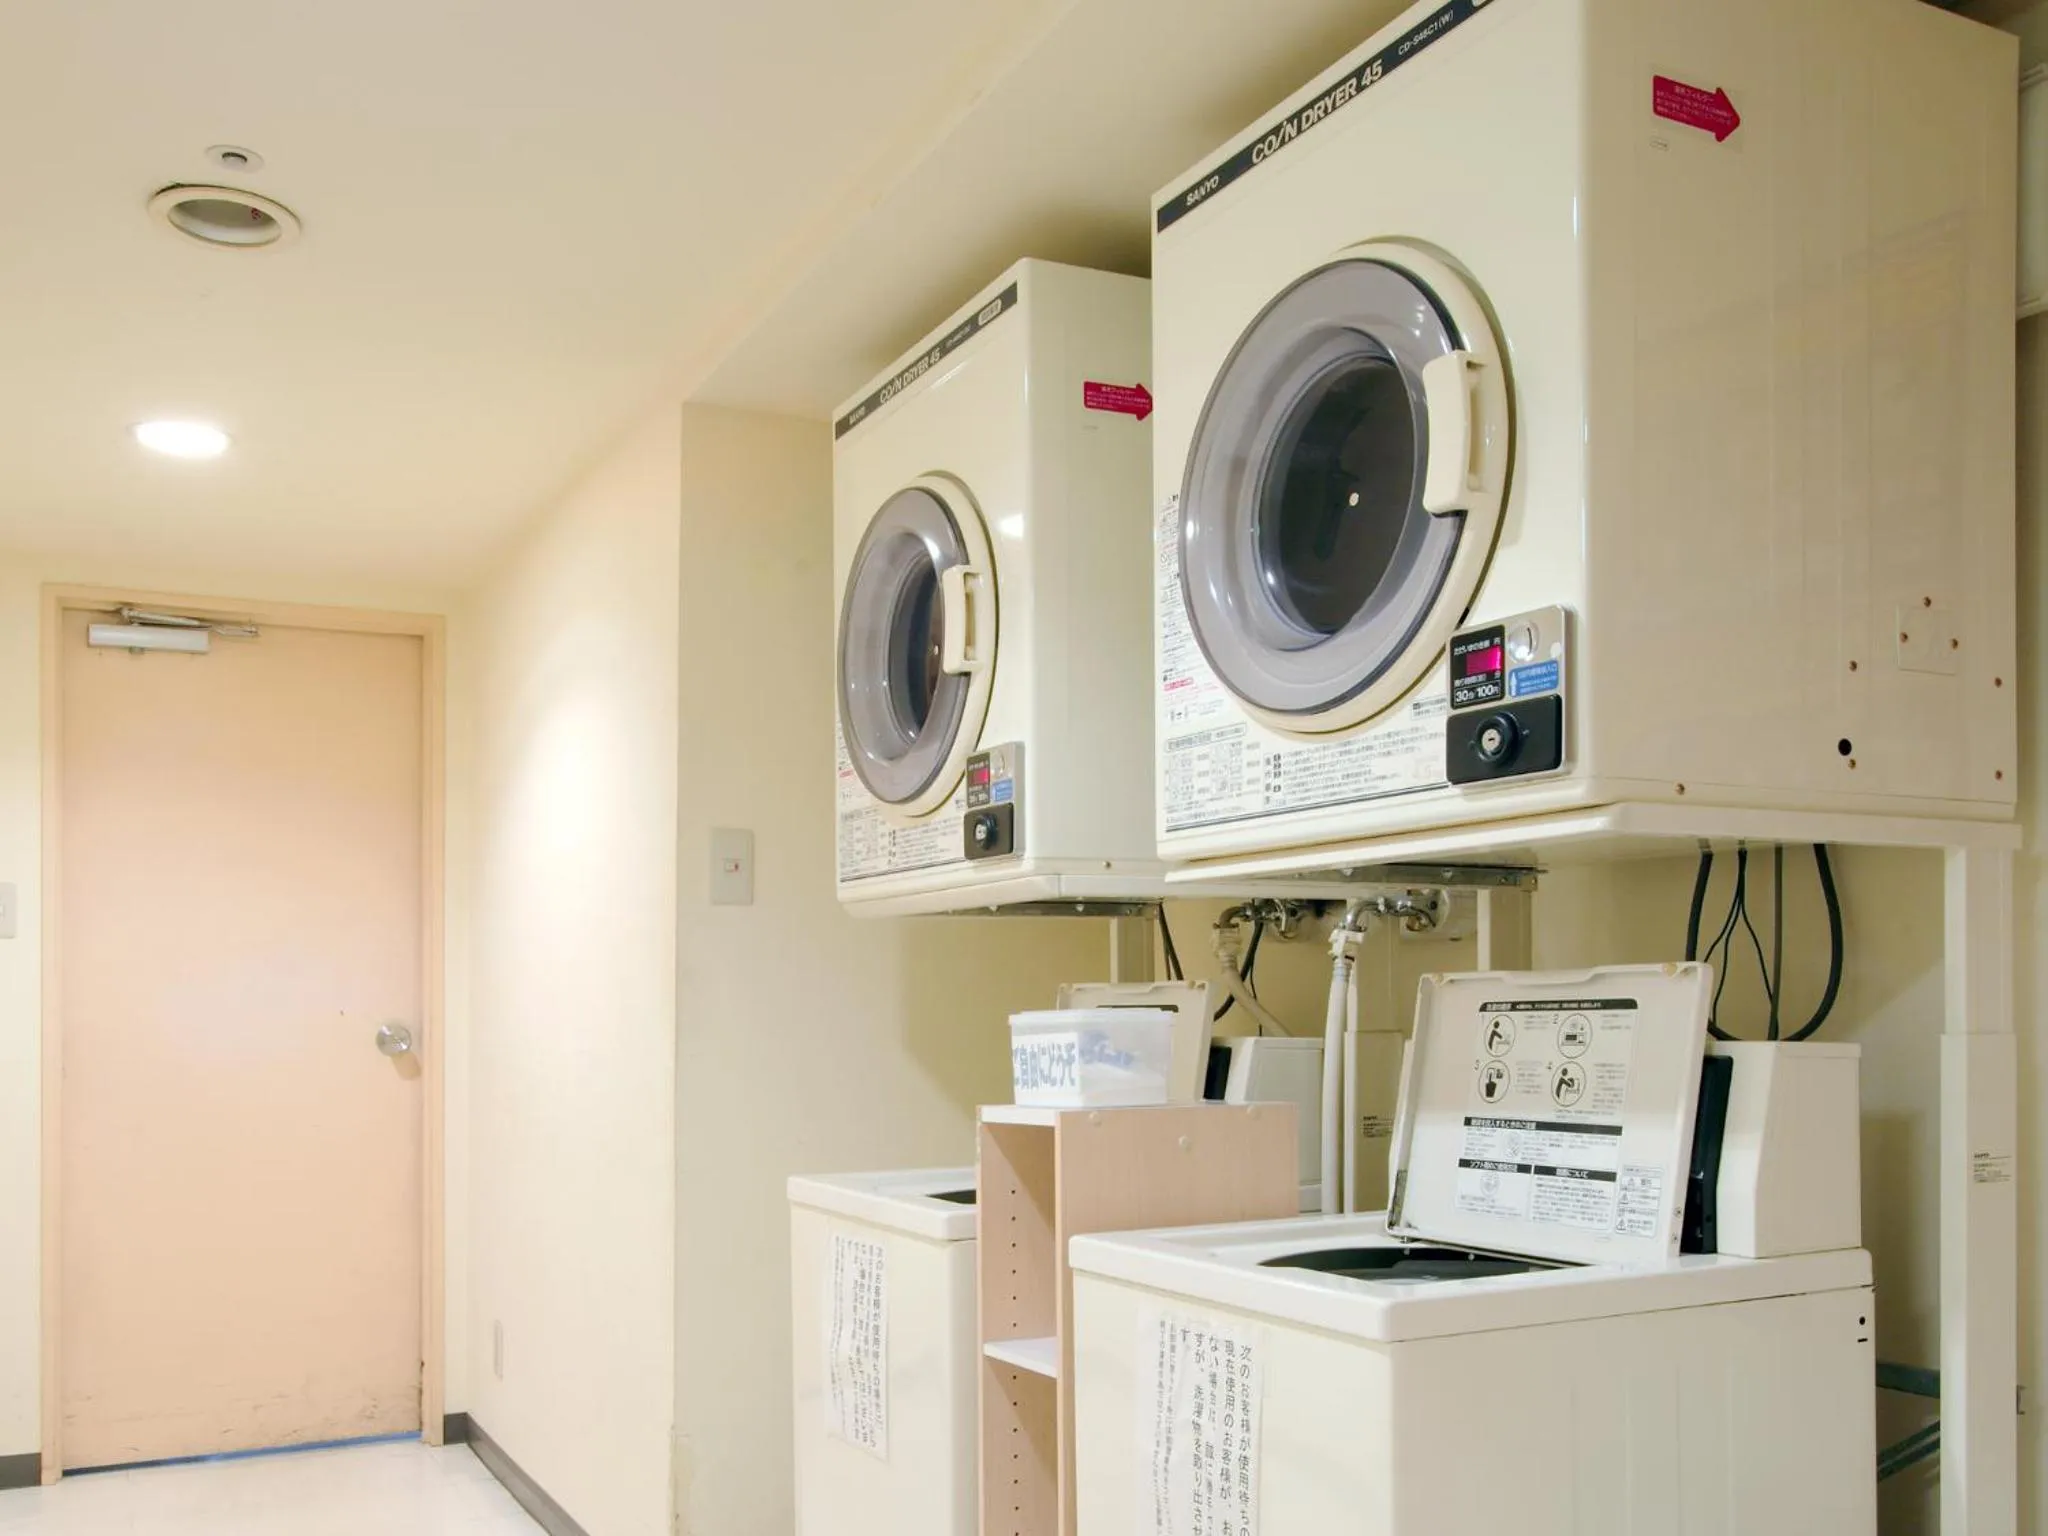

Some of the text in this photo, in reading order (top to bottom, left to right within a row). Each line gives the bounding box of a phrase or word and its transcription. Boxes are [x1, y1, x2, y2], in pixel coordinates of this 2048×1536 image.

[1186, 175, 1219, 206] SANYO
[1301, 77, 1358, 132] DRYER
[1361, 59, 1383, 87] 45
